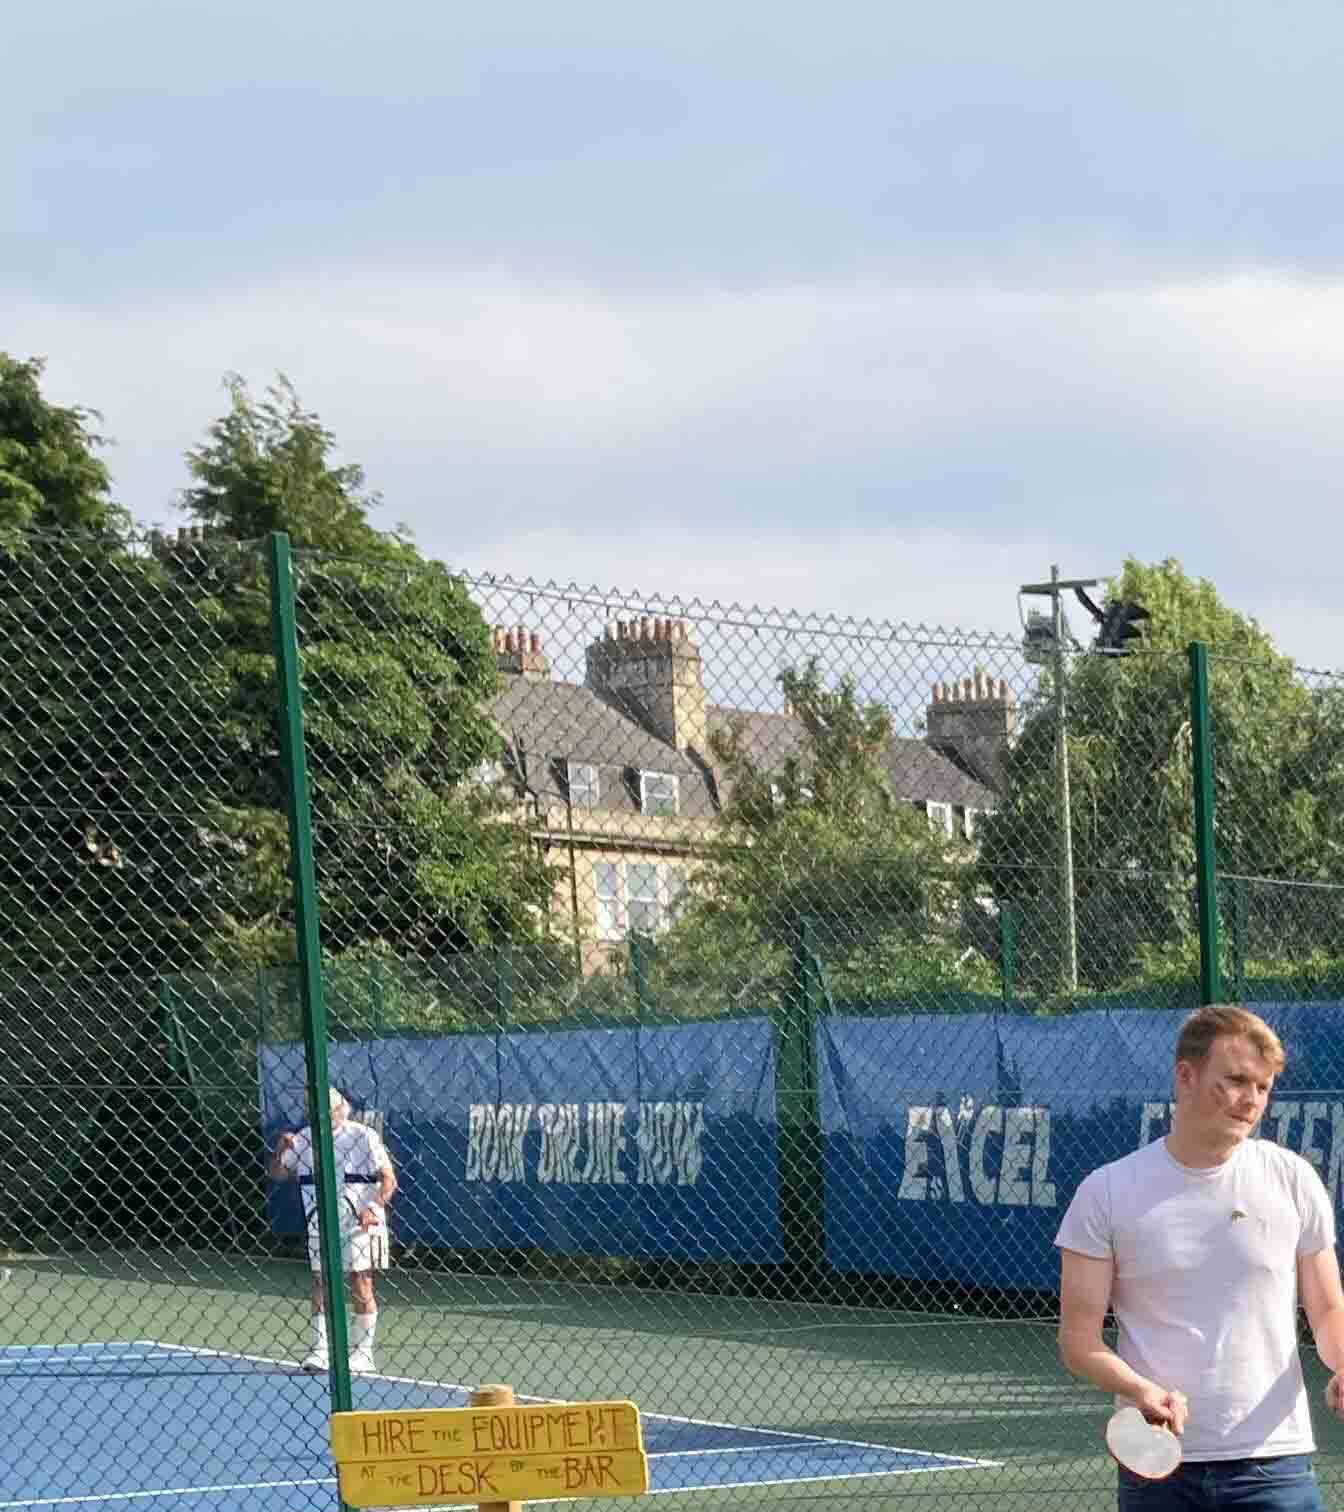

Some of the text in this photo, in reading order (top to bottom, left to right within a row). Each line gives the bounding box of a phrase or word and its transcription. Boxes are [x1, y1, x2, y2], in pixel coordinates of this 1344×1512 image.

[465, 1101, 704, 1184] BOOK ONLINE NOW
[362, 1407, 624, 1456] HIRE THE EQUIPMENT
[360, 1465, 377, 1480] AT
[386, 1474, 413, 1488] THE
[416, 1461, 499, 1496] DESK
[536, 1466, 561, 1480] THE
[562, 1455, 622, 1490] BAR
